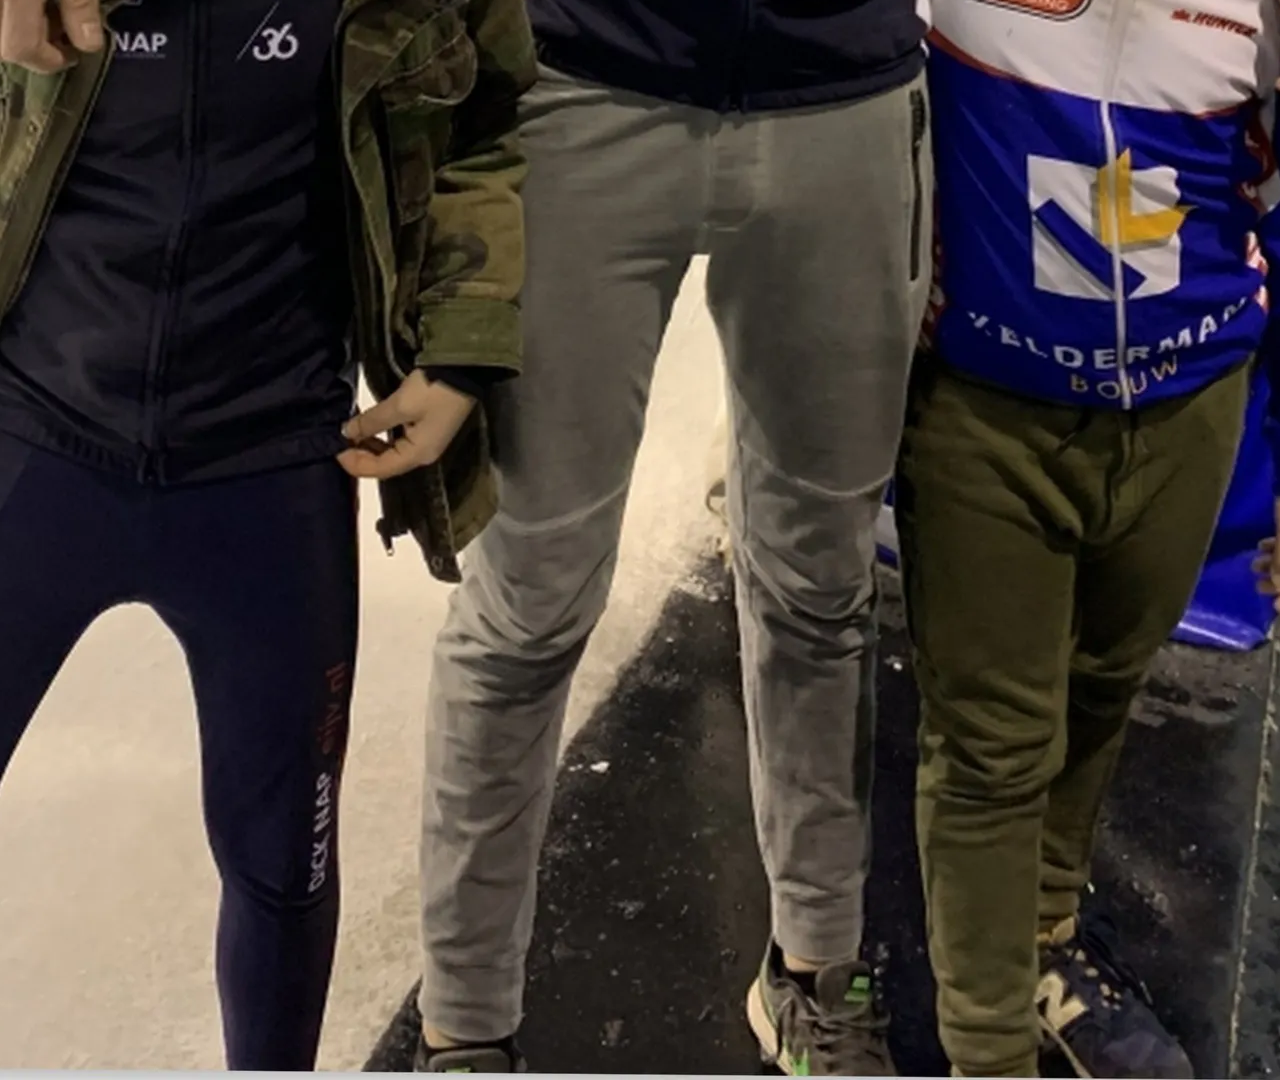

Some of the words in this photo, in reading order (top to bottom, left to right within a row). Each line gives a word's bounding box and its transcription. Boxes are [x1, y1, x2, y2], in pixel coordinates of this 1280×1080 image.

[115, 31, 168, 53] NAP
[1070, 354, 1179, 400] BOUW
[313, 772, 332, 834] NAP
